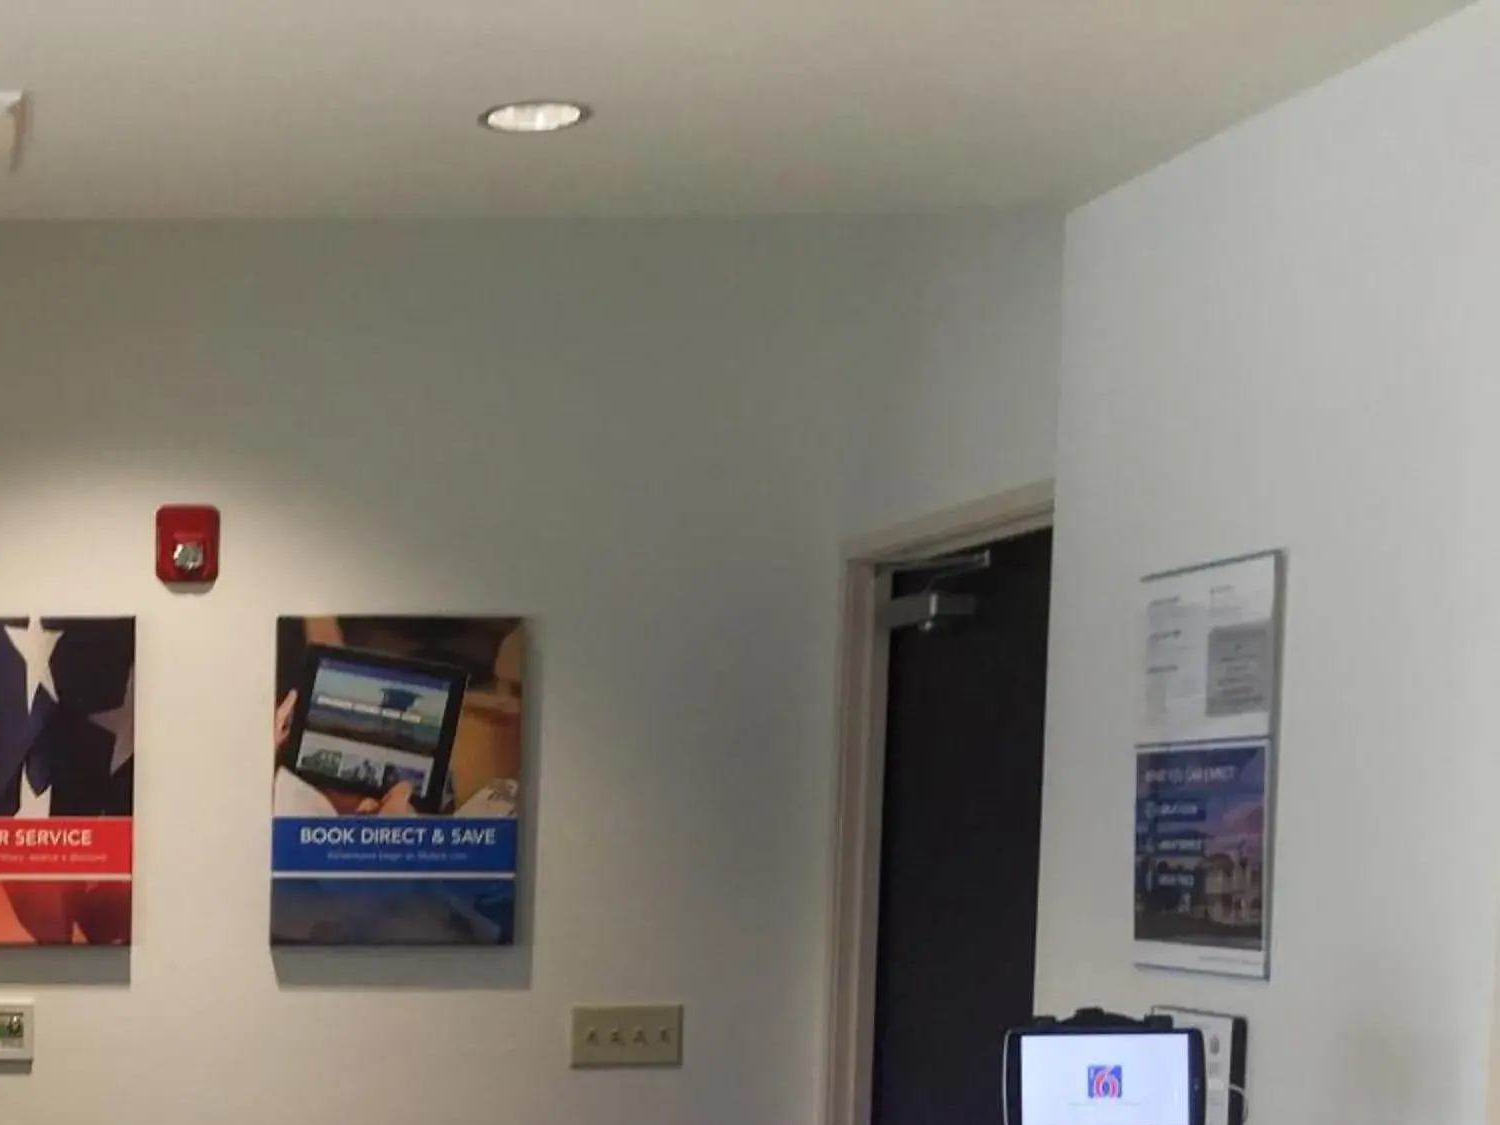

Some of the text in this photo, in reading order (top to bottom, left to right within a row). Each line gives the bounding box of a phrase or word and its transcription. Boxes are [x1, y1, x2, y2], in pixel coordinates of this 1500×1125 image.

[14, 828, 93, 847] SERVICE
[300, 826, 497, 845] BOOK DIRECT & SAVE
[1094, 1066, 1120, 1099] 6
